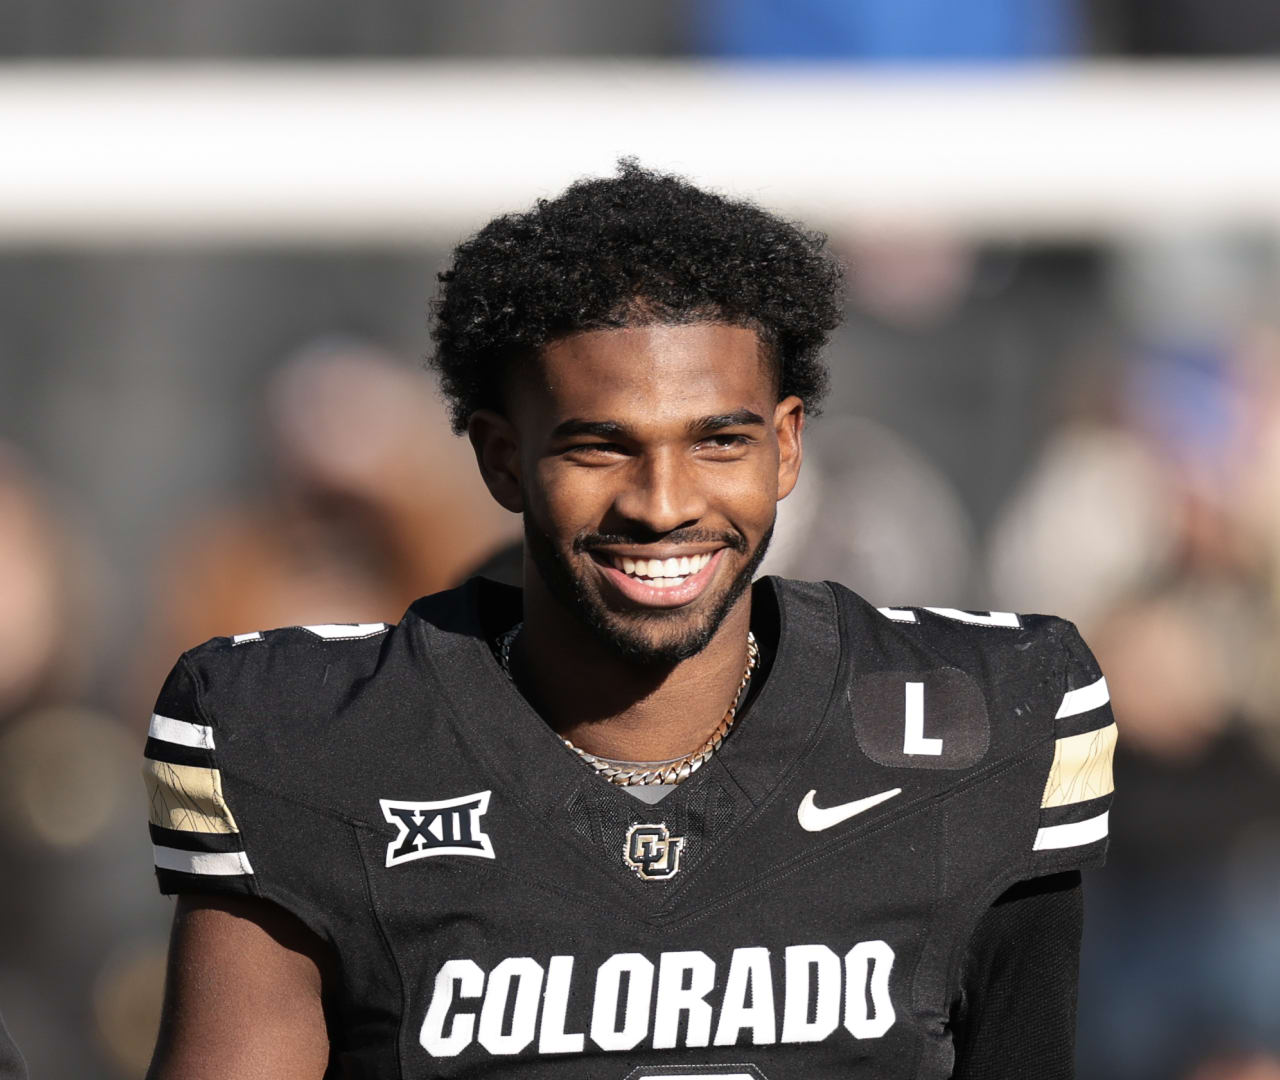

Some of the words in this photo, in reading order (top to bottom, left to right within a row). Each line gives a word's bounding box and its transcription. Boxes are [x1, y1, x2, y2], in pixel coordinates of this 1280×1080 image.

[903, 682, 943, 756] L
[390, 799, 488, 856] XII
[624, 823, 684, 880] CU
[419, 939, 897, 1058] COLORADO
